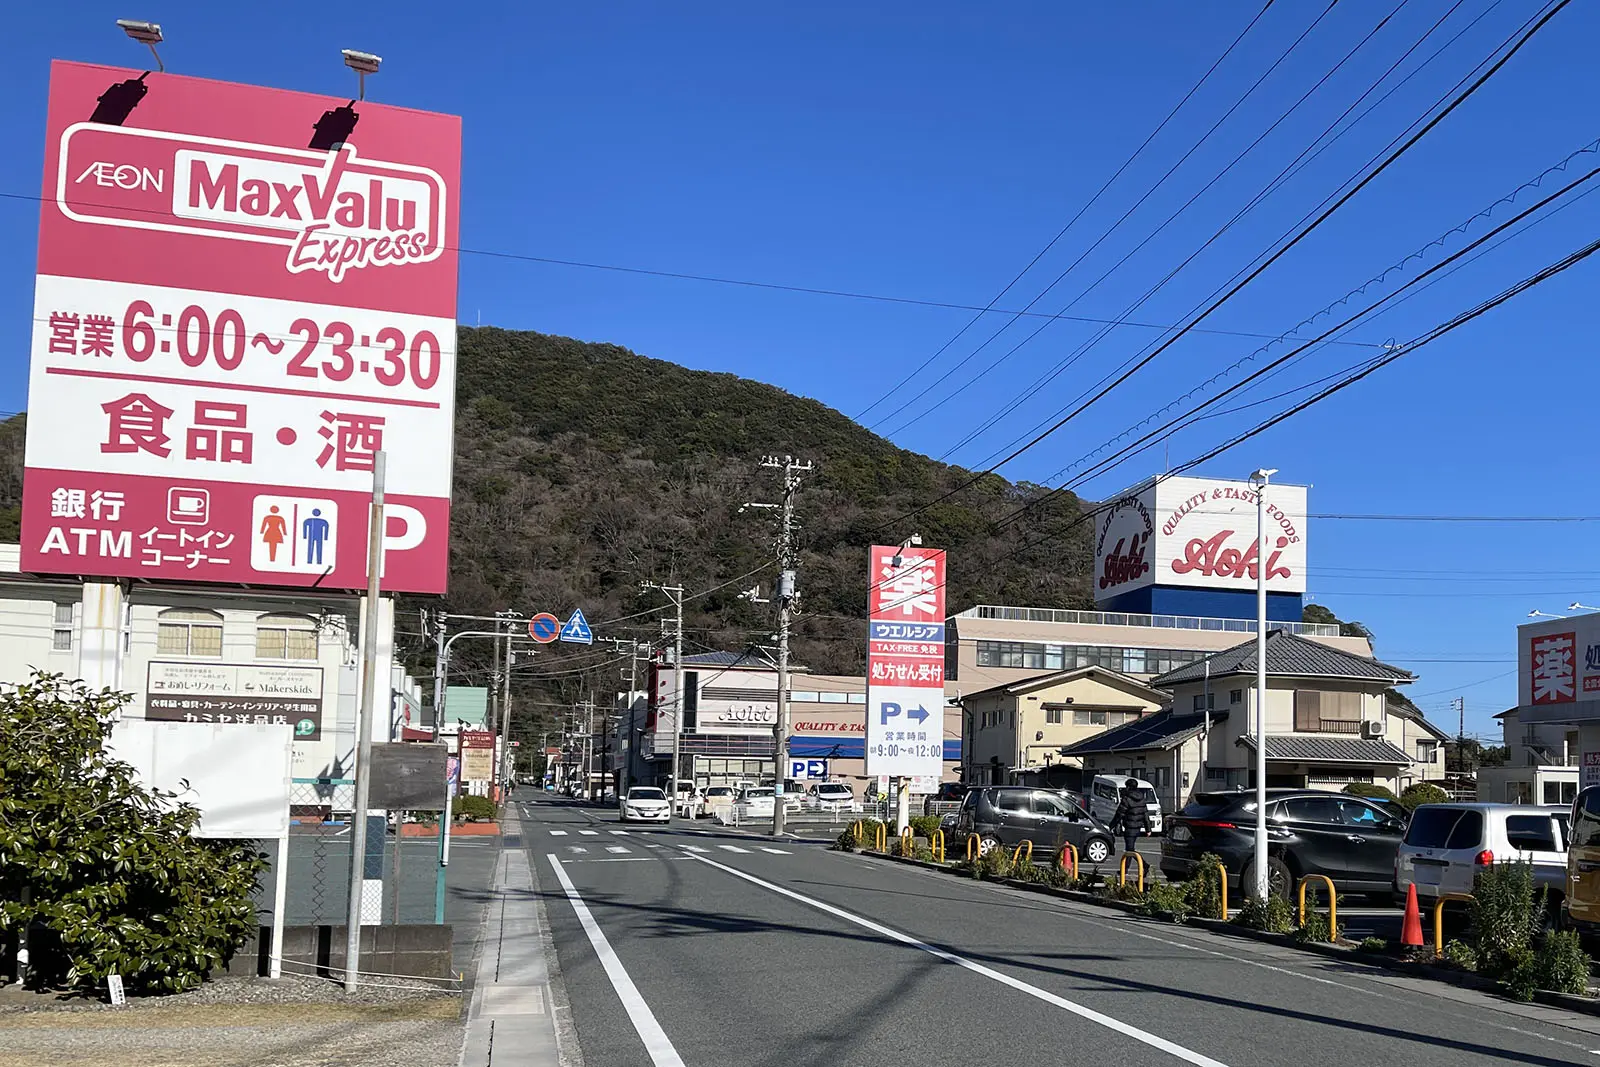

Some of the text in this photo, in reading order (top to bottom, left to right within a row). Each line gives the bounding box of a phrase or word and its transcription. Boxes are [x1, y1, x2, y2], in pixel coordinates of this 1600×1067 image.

[188, 148, 416, 232] MaxValu
[292, 224, 426, 276] Express
[51, 487, 125, 521] 銀行
[1162, 487, 1300, 544] QUALITY & TAST FOODS
[40, 526, 132, 558] ATM
[139, 526, 235, 549] イートイン
[366, 502, 427, 578] P
[141, 548, 230, 569] コーナー
[1171, 529, 1291, 581] Aoki
[879, 554, 937, 616] 薬
[876, 624, 939, 639] ウエルシア
[872, 661, 943, 682] 処方せん受付
[1535, 637, 1573, 700] 薬
[259, 684, 313, 694] Makerskids
[718, 704, 772, 721] Aoki
[881, 702, 901, 725] P
[794, 722, 838, 732] QUALITY
[839, 723, 848, 732] &
[885, 731, 927, 741] 営業時間
[792, 762, 805, 777] P
